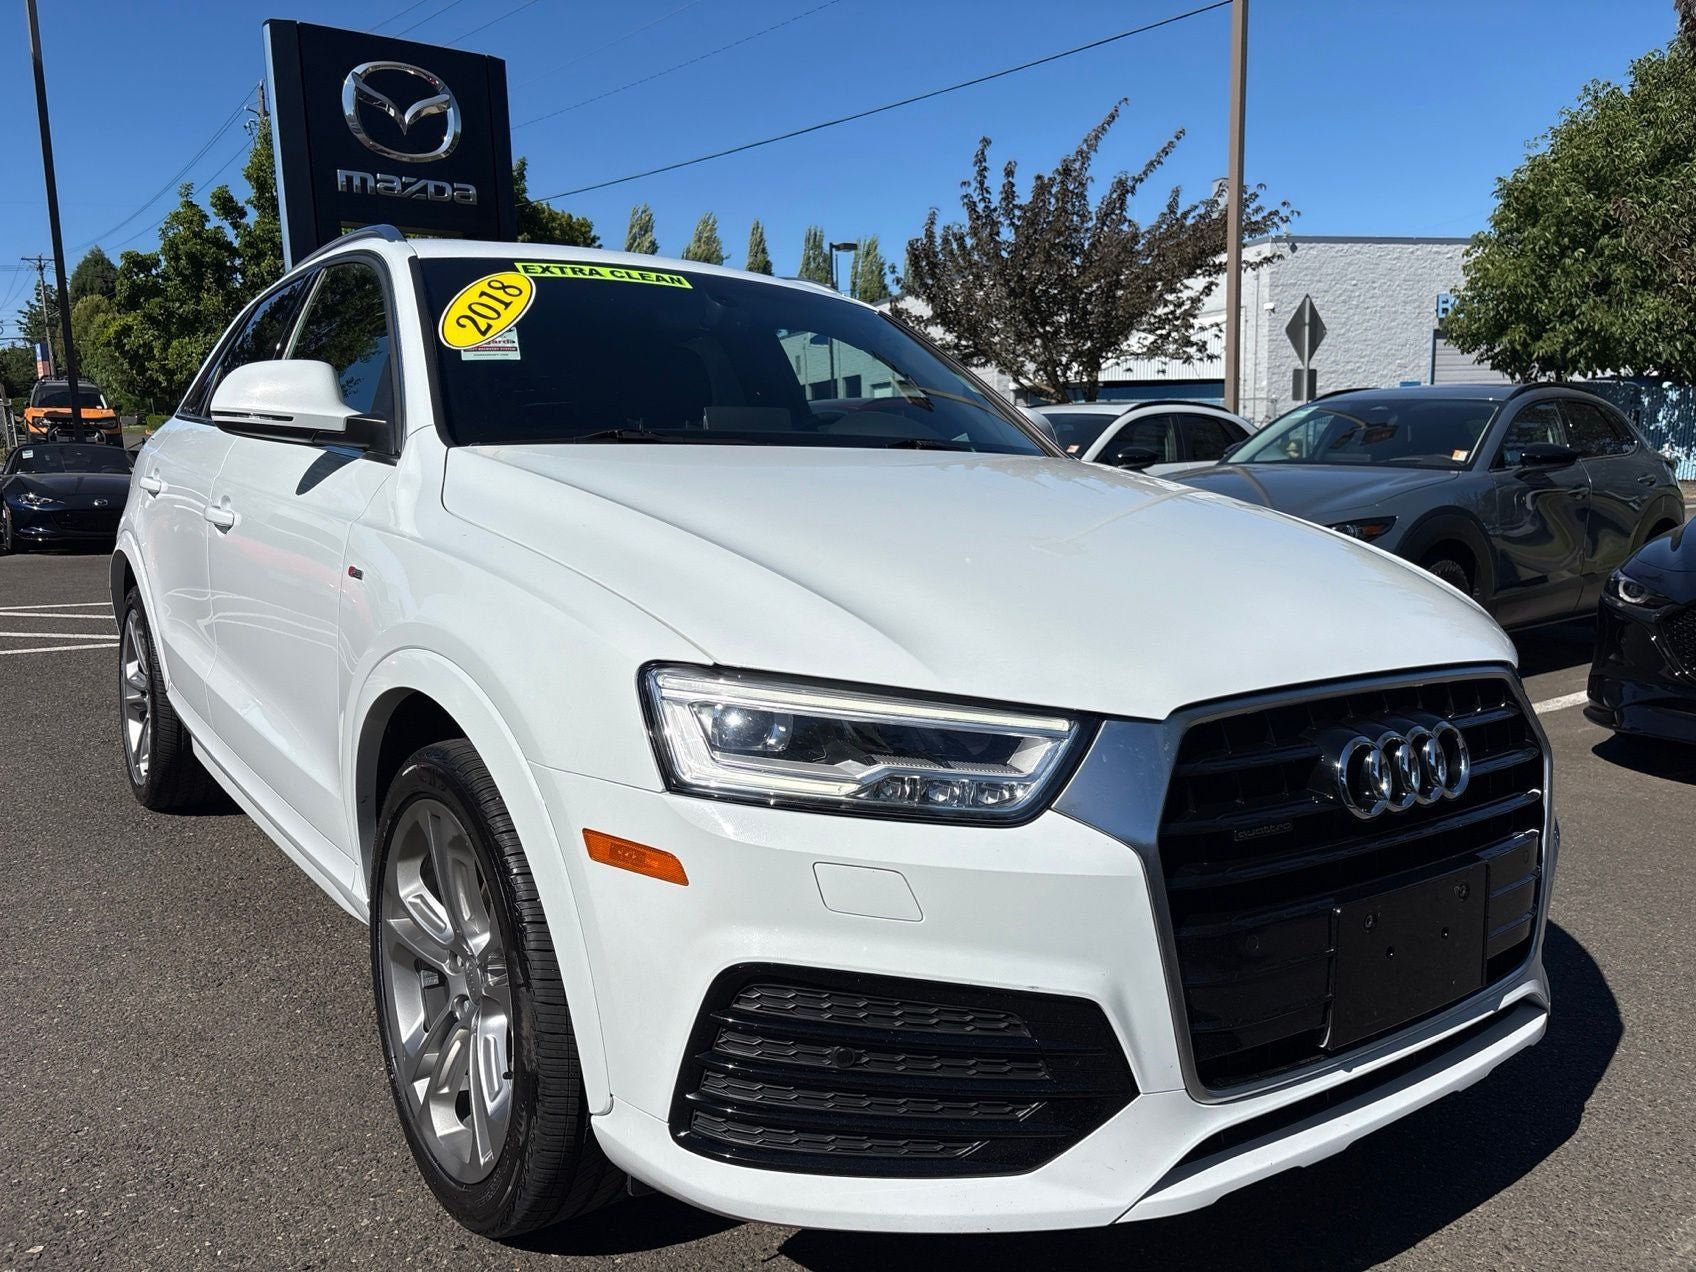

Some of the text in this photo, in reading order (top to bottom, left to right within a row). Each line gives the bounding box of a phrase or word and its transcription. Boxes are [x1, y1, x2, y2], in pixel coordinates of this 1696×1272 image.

[521, 264, 686, 286] EXTRA CLEAN
[456, 279, 523, 337] 2018
